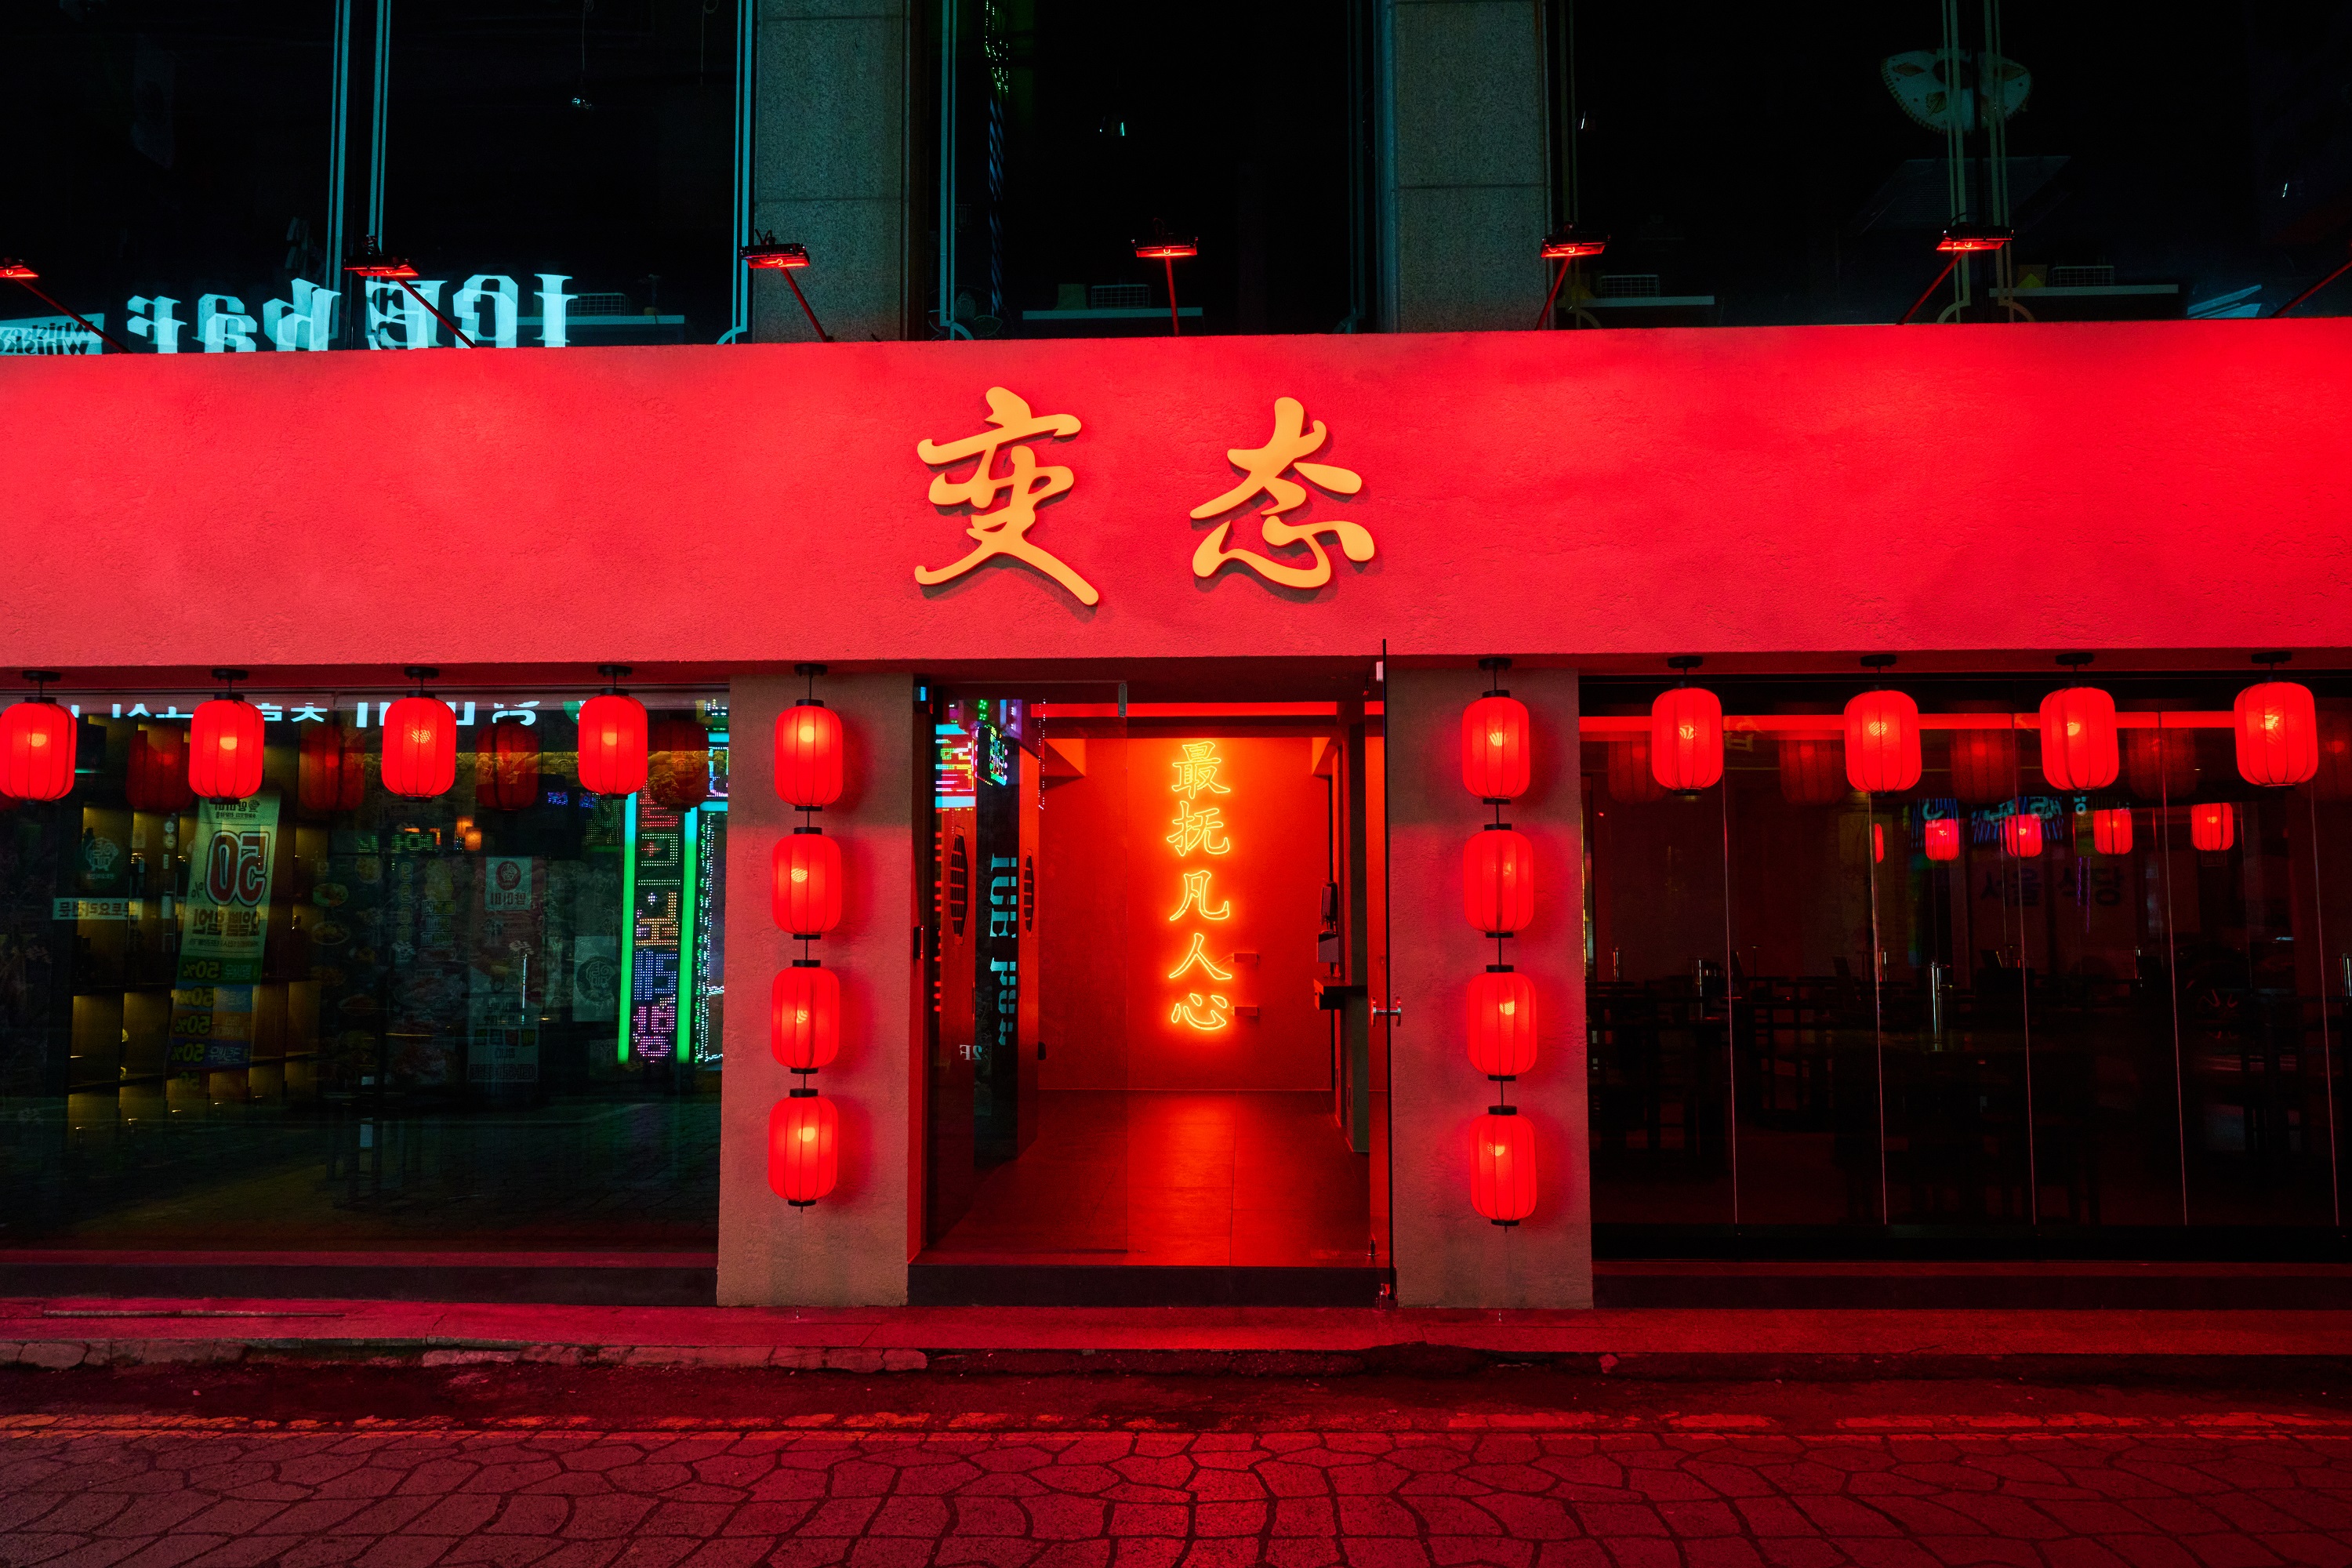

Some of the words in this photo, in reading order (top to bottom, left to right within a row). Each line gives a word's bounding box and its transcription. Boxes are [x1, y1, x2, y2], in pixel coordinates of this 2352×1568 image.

[914, 386, 1375, 607] 变态
[1167, 740, 1232, 1031] 最抚凡人心
